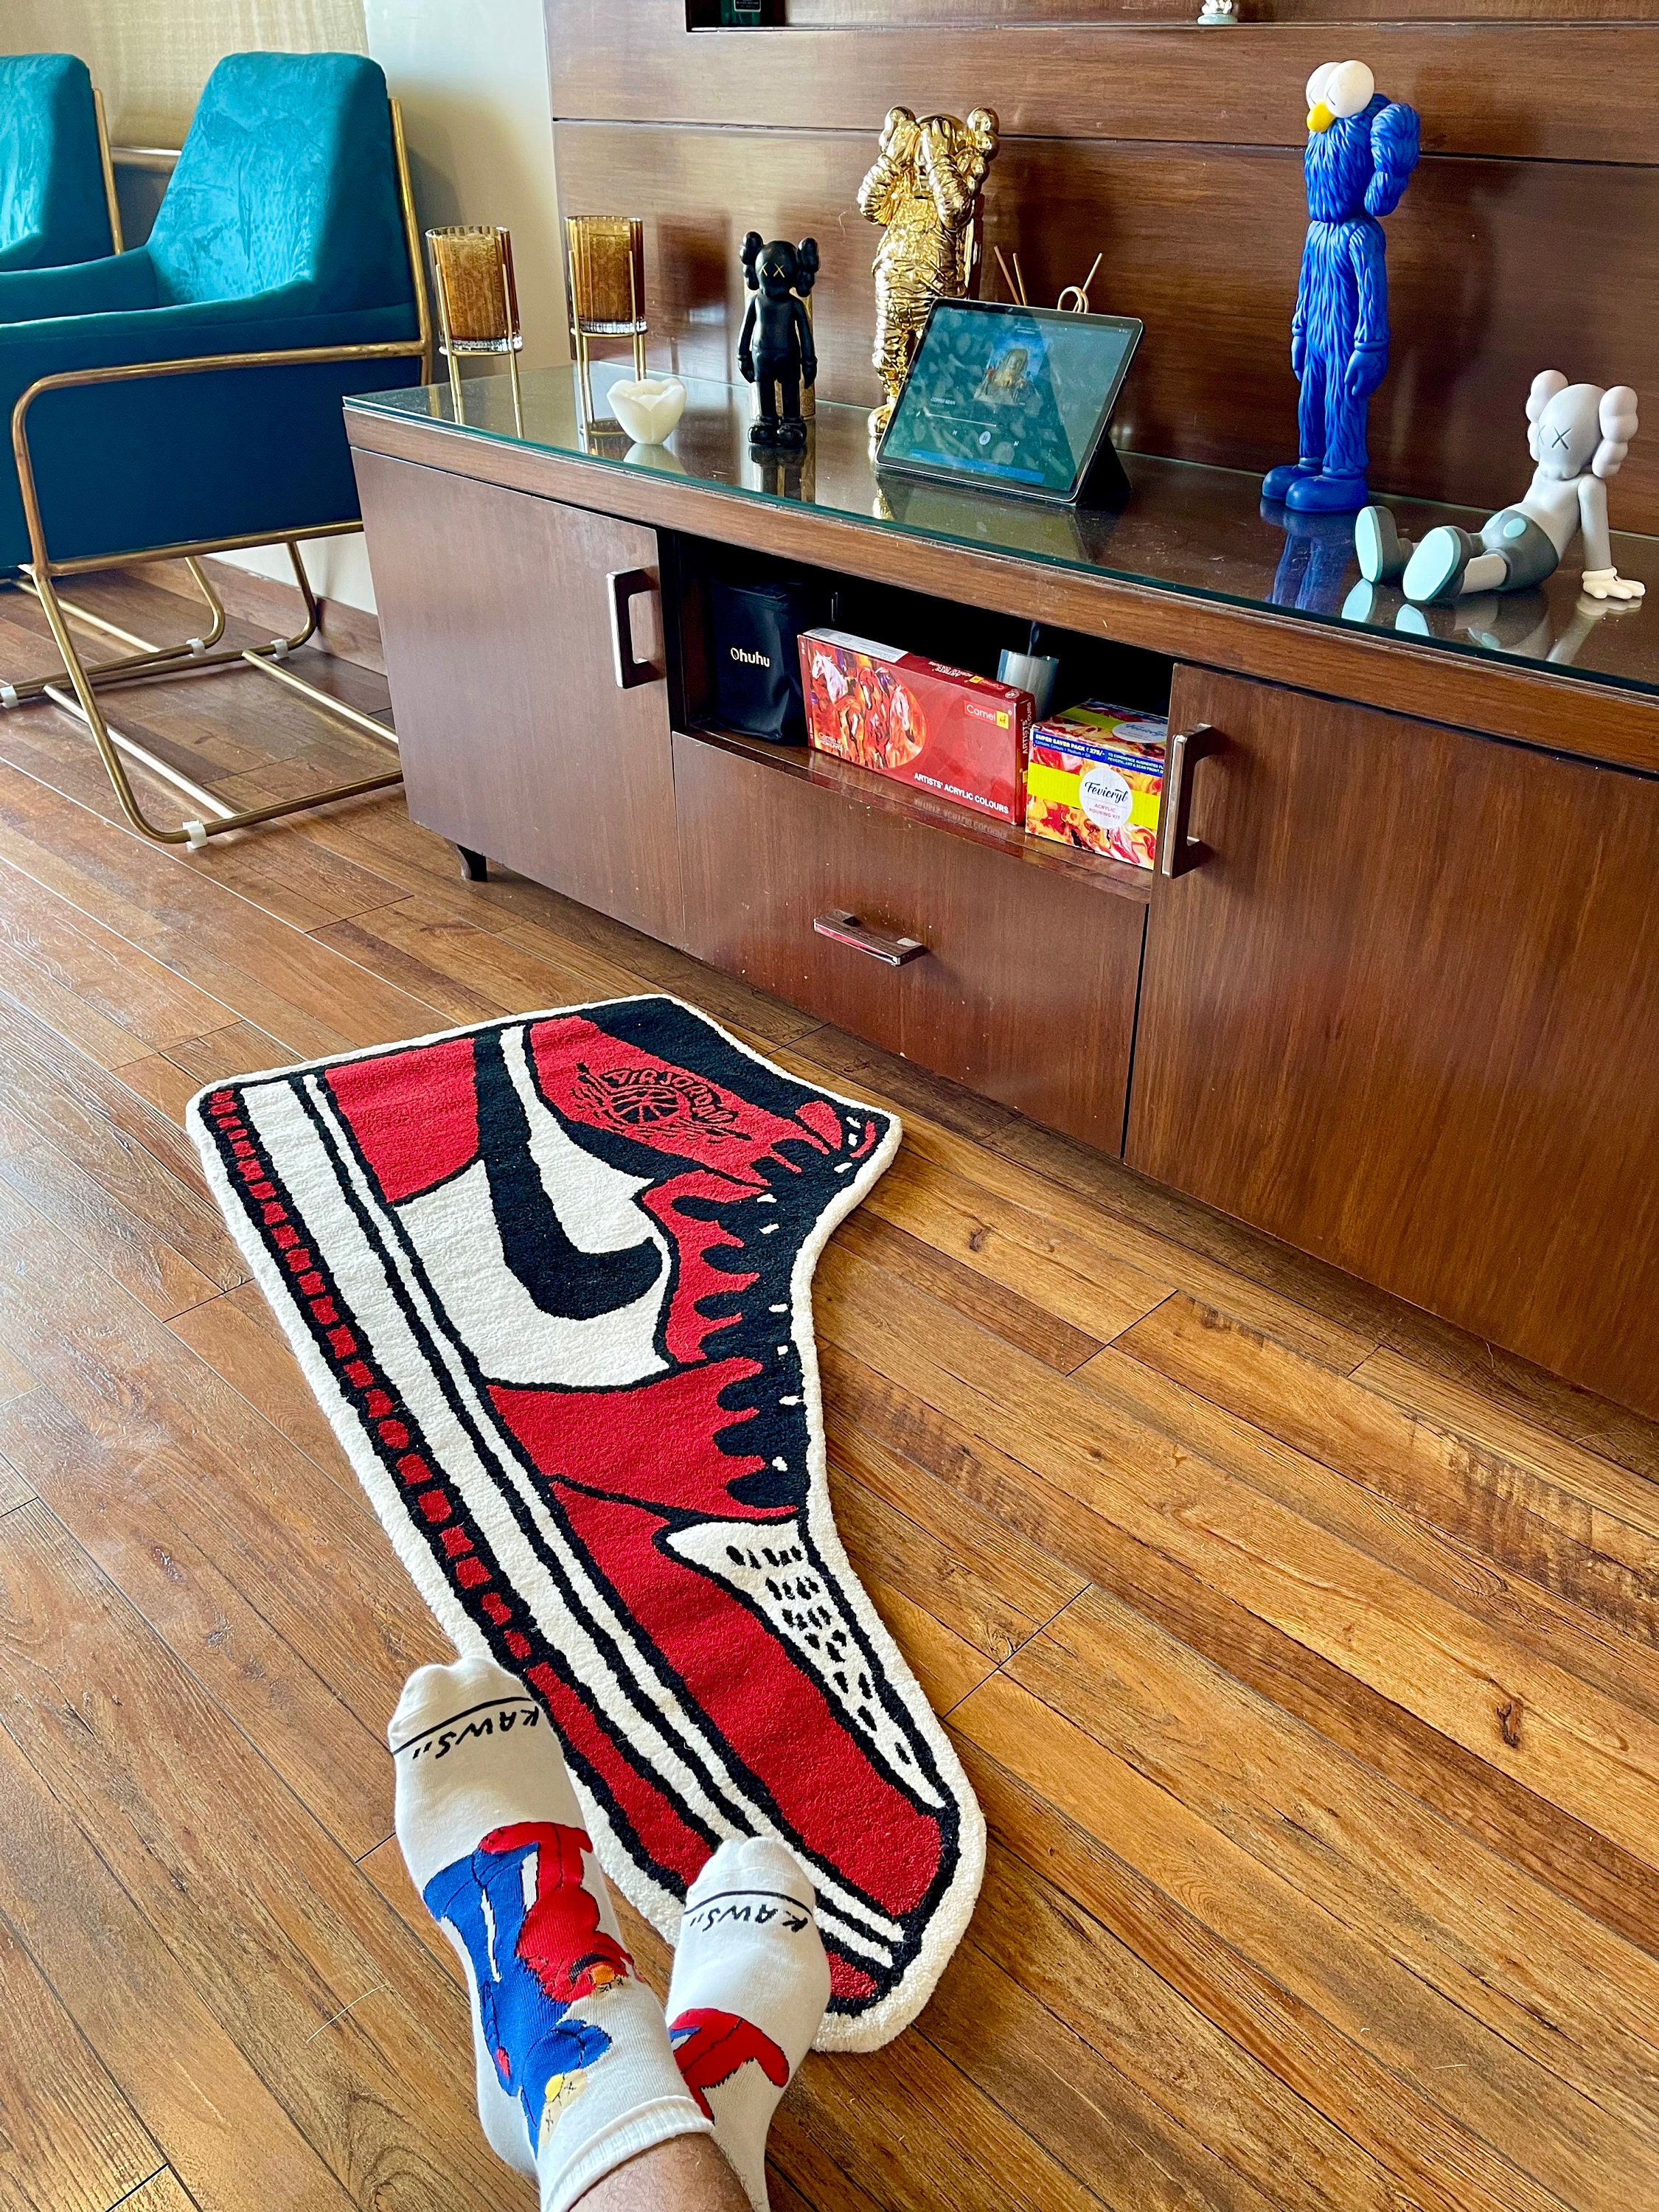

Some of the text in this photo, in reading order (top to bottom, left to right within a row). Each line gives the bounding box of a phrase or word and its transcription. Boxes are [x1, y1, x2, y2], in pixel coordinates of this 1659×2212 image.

[730, 647, 771, 667] Ohuhu
[966, 703, 996, 720] Camel
[1071, 743, 1085, 751] PACK
[914, 772, 1009, 814] ARTISTS' ACRYLIC COLOURS
[1085, 782, 1129, 804] Fevicryl
[1089, 807, 1111, 818] POURING
[1094, 803, 1116, 813] ACRYLIC
[603, 1069, 734, 1122] AIR JORDAN
